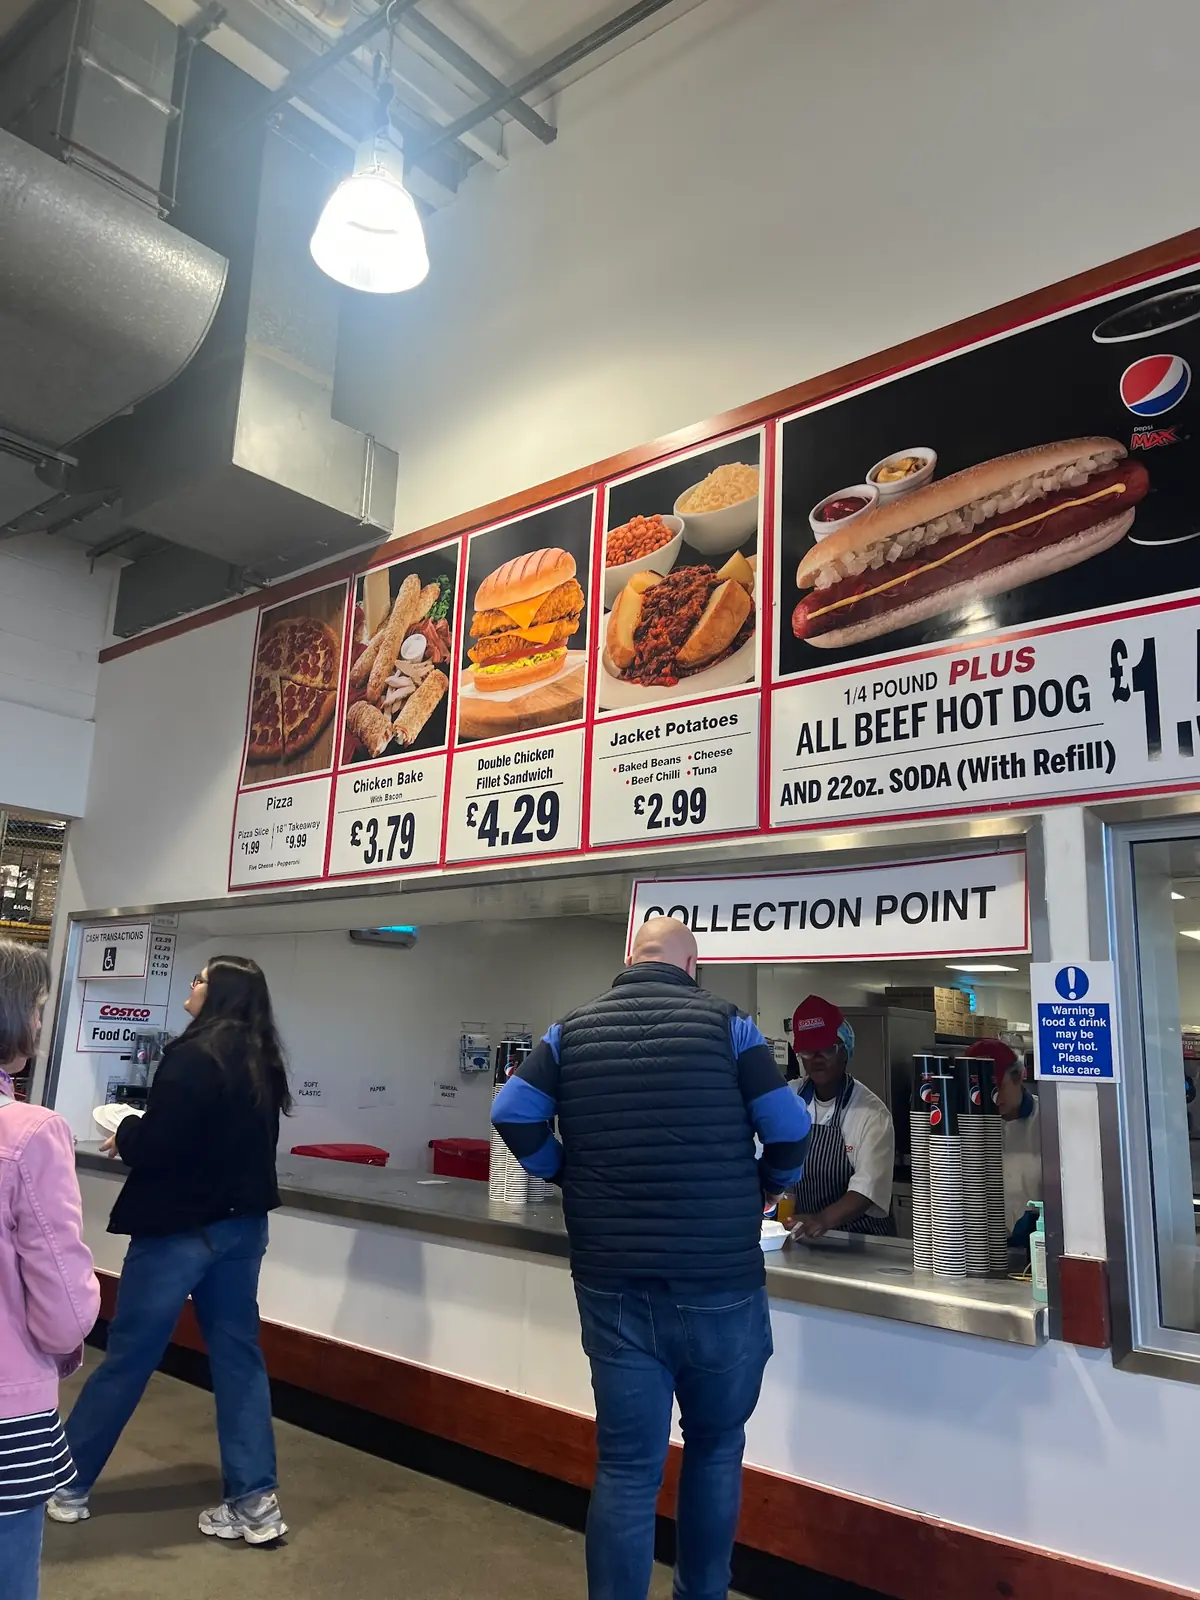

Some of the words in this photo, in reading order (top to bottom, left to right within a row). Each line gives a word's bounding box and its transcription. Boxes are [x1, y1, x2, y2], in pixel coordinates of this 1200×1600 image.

[1133, 425, 1154, 433] pepsi
[1130, 428, 1178, 450] MAX
[844, 685, 867, 705] 1/4
[873, 671, 938, 700] POUND
[949, 646, 1035, 685] PLUS
[1110, 629, 1200, 762] £1.
[796, 717, 847, 756] ALL
[855, 701, 927, 747] BEEF
[936, 688, 1003, 735] HOT
[1013, 674, 1091, 723] DOG
[610, 725, 660, 746] Jacket
[666, 713, 738, 737] Potatoes
[478, 755, 511, 771] Double
[514, 748, 554, 764] Chicken
[694, 748, 733, 760] Cheese
[618, 760, 648, 773] Baked
[651, 756, 681, 768] Beans
[692, 766, 717, 776] Tuna
[477, 775, 501, 789] Fillet
[503, 766, 553, 786] Sandwich
[631, 774, 653, 785] Beef
[656, 770, 680, 781] Chilli
[780, 779, 822, 807] AND
[827, 774, 884, 801] 22oz.
[889, 761, 952, 793] SODA
[957, 752, 1026, 792] (With
[1034, 739, 1116, 776] Refill)
[353, 777, 393, 793] Chicken
[397, 770, 423, 785] Bake
[266, 796, 293, 810] Pizza
[385, 793, 402, 801] Bacon
[634, 787, 707, 829] £2.99
[466, 790, 560, 847] £4.29
[238, 830, 253, 839] Pizza
[254, 827, 269, 836] Slice
[288, 821, 320, 831] Takeaway
[286, 833, 307, 848] £9.99
[350, 812, 415, 864] £3.79
[241, 841, 260, 855] £1.99
[277, 859, 300, 867] Pepperoni
[875, 885, 997, 926] POINT
[86, 934, 99, 943] CASH
[100, 931, 144, 942] TRANSACTIONS
[100, 1005, 151, 1018] COSTCO
[1052, 1006, 1095, 1017] Warning
[1042, 1017, 1066, 1027] food
[1069, 1018, 1076, 1027] &
[1079, 1018, 1107, 1027] drink
[92, 1027, 120, 1041] Food
[1056, 1031, 1077, 1040] may
[1081, 1030, 1094, 1039] be
[1052, 1043, 1075, 1052] very
[1078, 1042, 1098, 1051] hot.
[1059, 1053, 1094, 1063] Please
[1052, 1065, 1075, 1074] take
[1078, 1067, 1101, 1075] care
[369, 1085, 386, 1093] PAPER
